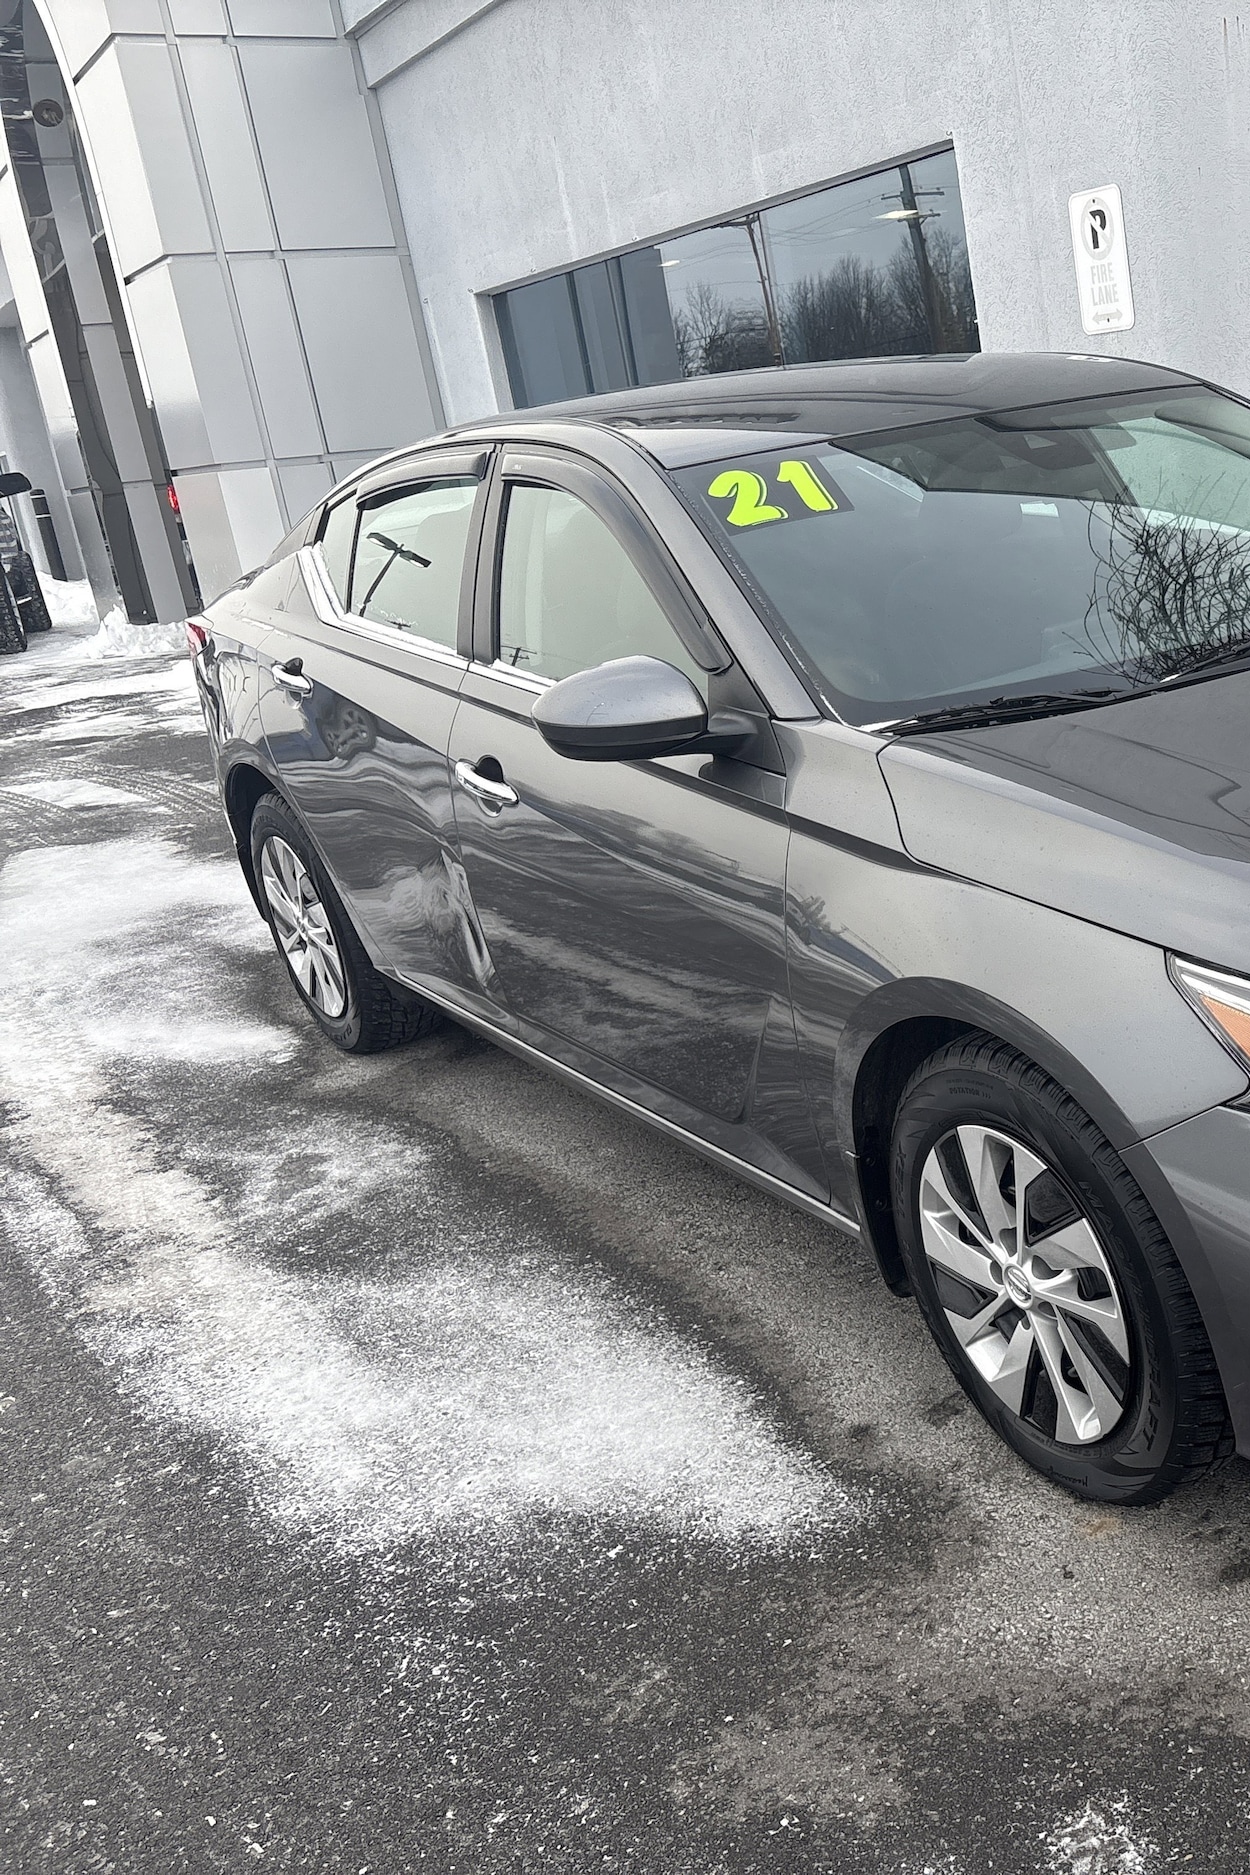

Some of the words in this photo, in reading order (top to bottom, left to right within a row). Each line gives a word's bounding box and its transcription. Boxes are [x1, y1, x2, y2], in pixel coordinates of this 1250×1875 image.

[1090, 262, 1115, 284] FIRE
[1091, 284, 1119, 306] LANE
[707, 460, 839, 527] 21
